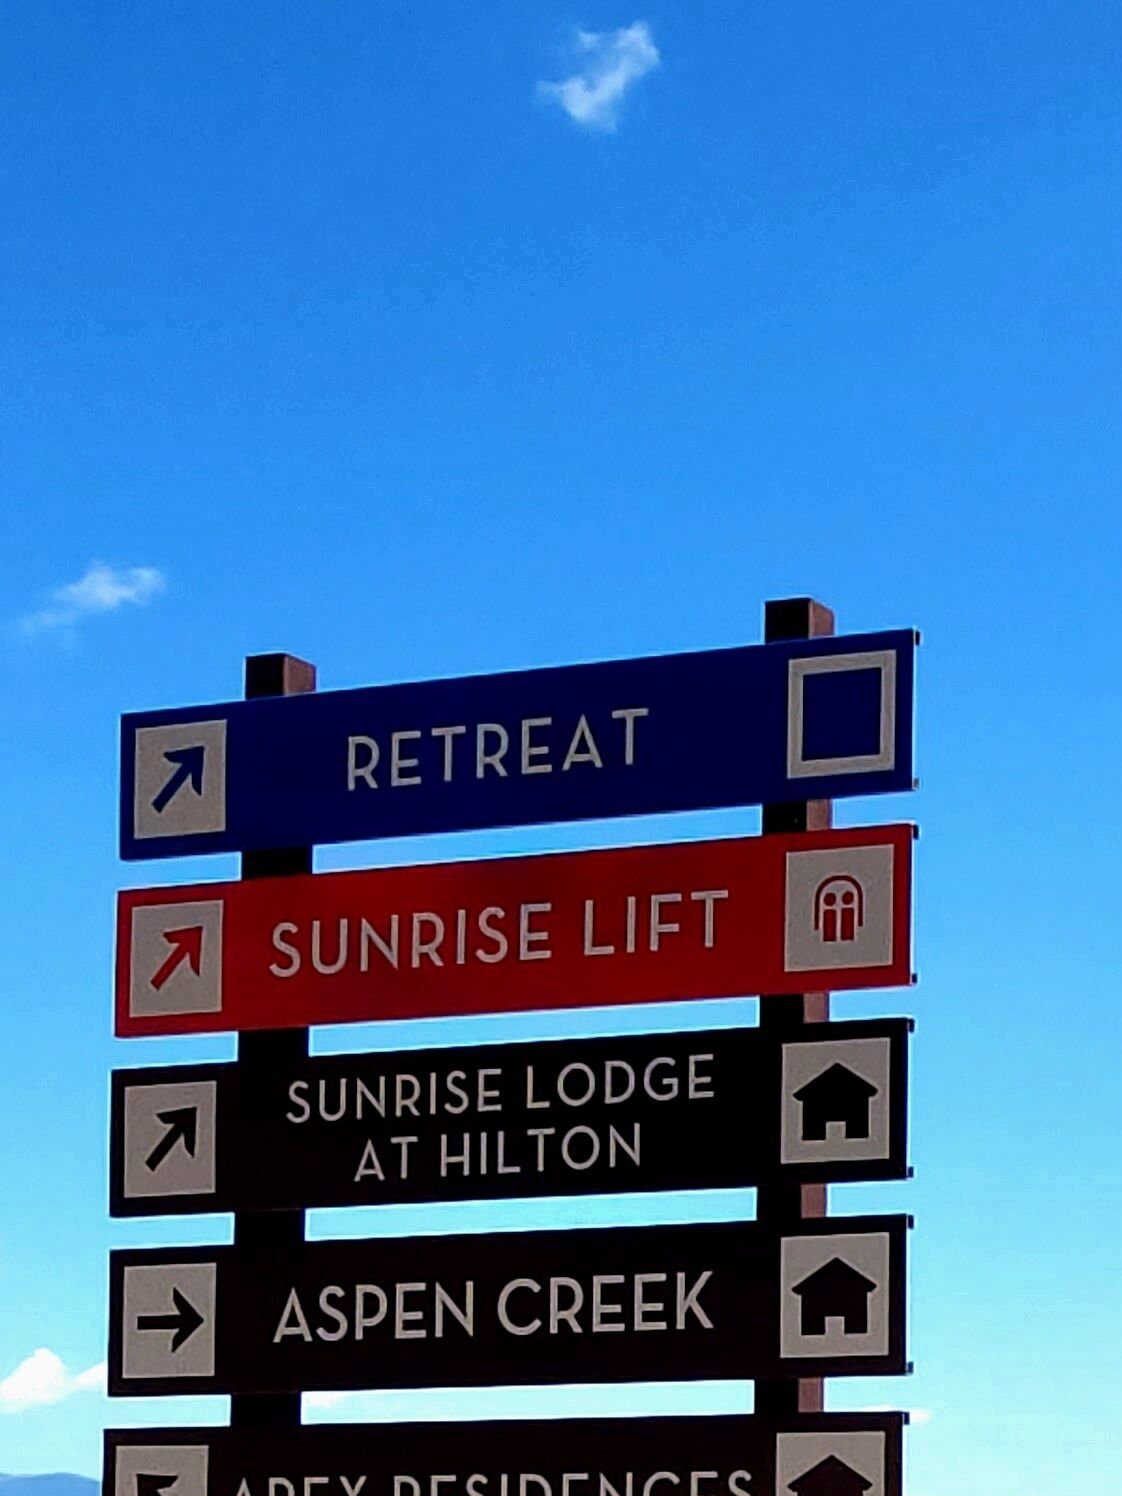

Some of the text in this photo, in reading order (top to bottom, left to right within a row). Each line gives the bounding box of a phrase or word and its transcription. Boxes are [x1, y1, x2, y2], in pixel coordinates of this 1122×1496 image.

[347, 708, 649, 791] RETREAT
[269, 889, 729, 978] SUNRISE LIFT
[286, 1053, 715, 1124] SUNRISE LODGE
[354, 1122, 641, 1182] AT HILTON
[272, 1270, 714, 1343] ASPEN CREEK
